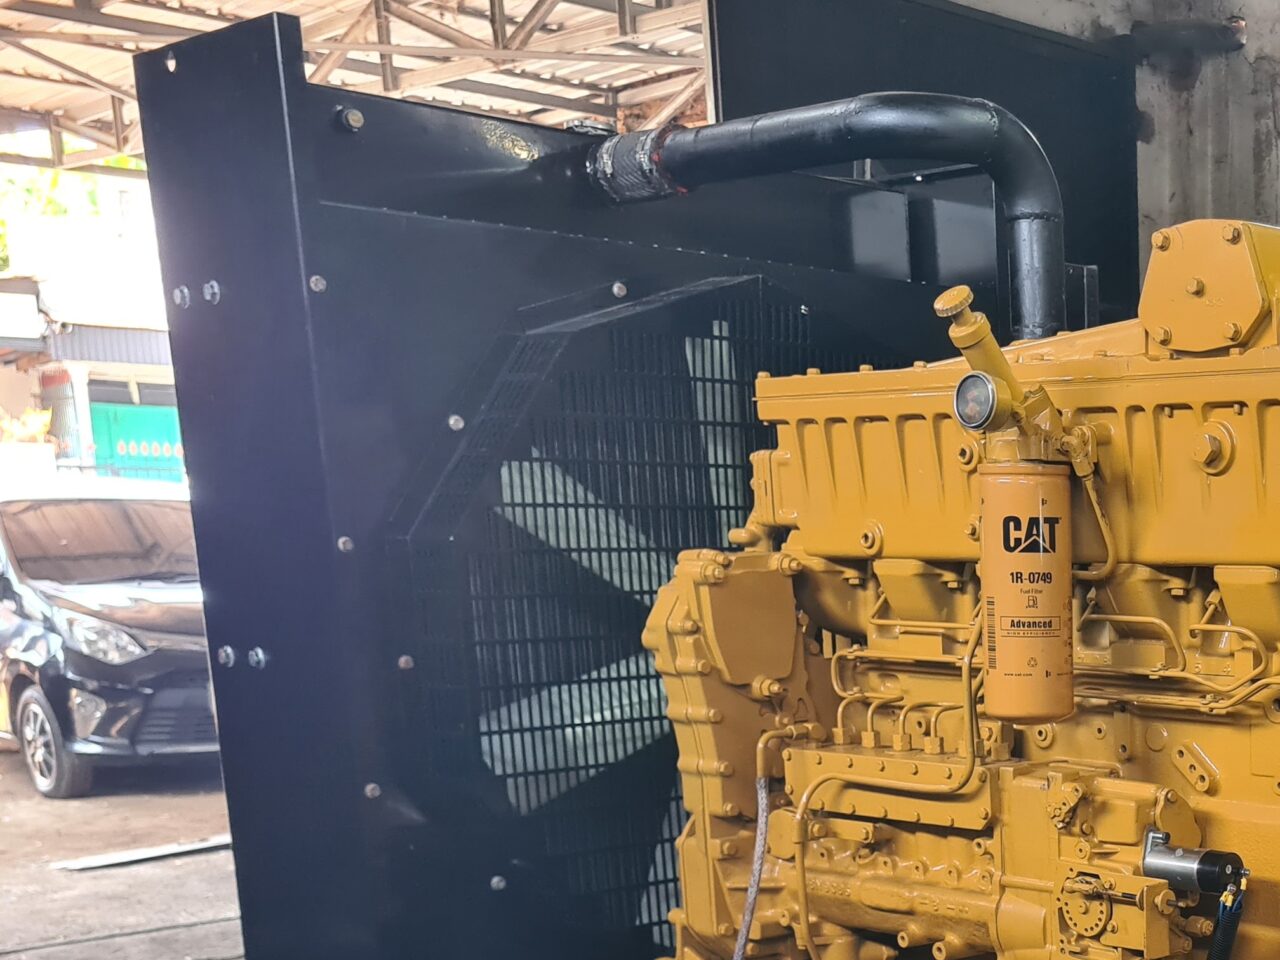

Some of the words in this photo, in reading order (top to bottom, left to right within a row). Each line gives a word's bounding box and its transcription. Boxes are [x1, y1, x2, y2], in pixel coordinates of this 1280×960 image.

[1002, 515, 1060, 554] CAT
[1009, 571, 1053, 585] 1R-0749
[1010, 619, 1053, 629] Advanced
